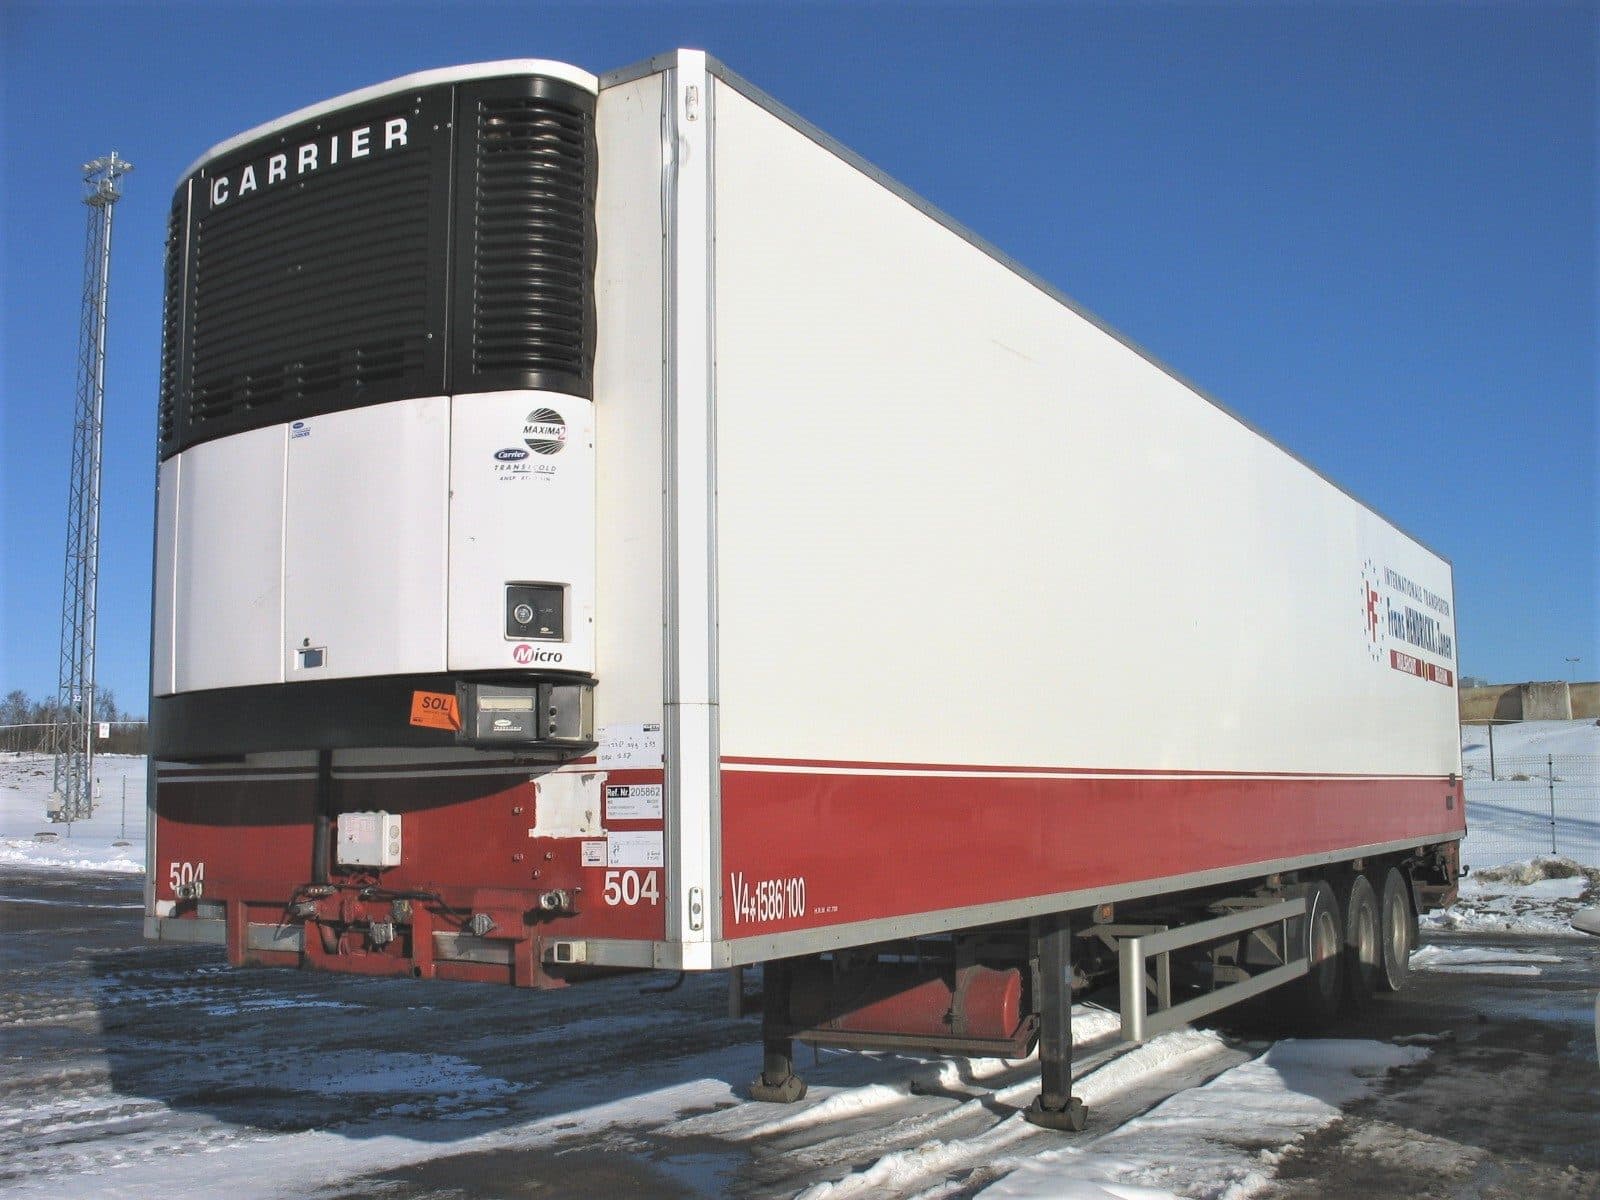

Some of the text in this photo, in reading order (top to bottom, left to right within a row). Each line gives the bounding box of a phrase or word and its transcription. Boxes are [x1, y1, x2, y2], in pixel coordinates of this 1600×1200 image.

[213, 117, 408, 206] CARRIER
[498, 449, 527, 461] Carrier
[513, 644, 563, 665] Micro
[630, 786, 661, 797] 205862
[604, 869, 660, 906] 504
